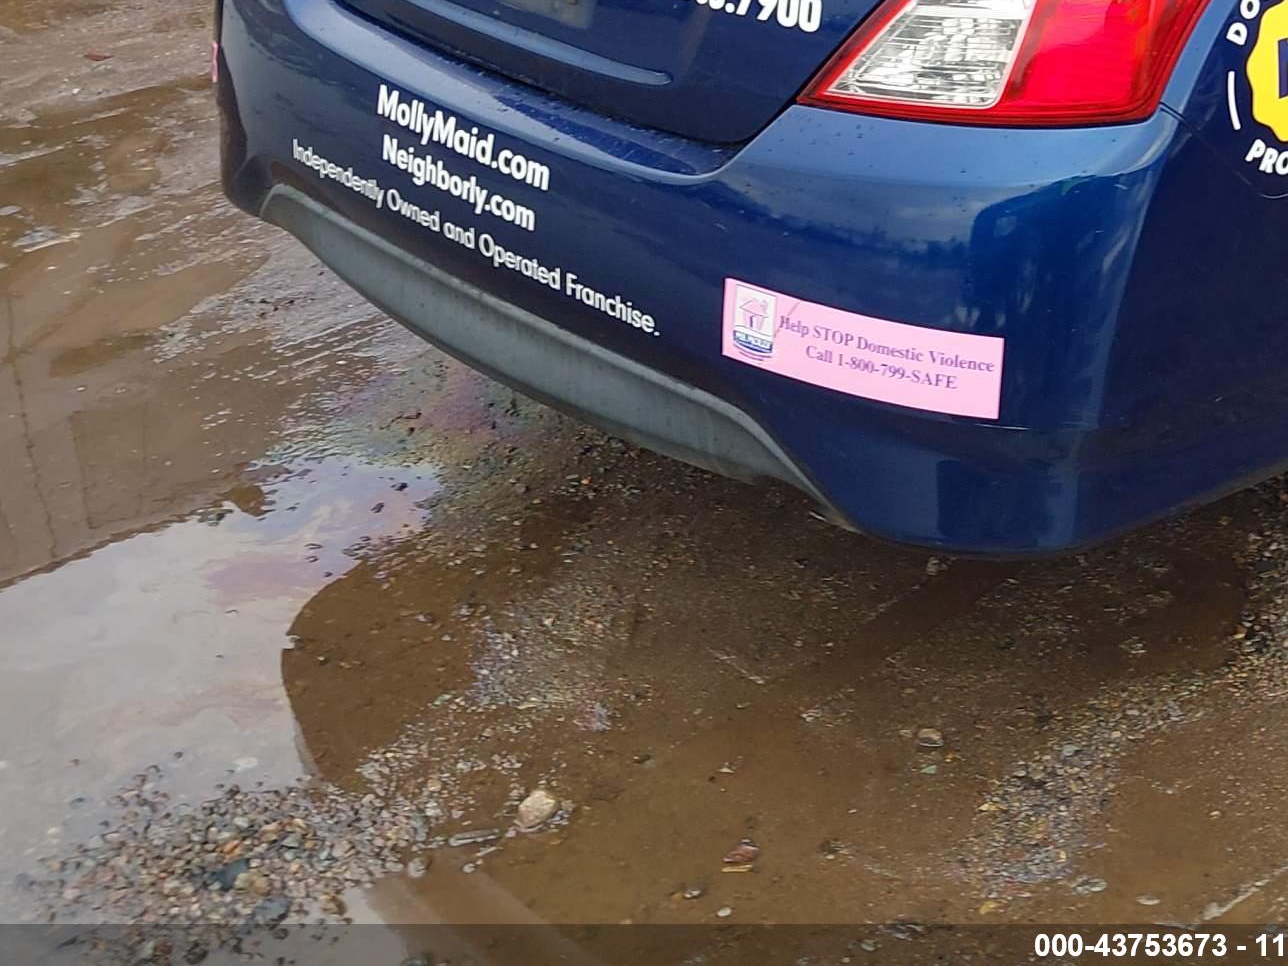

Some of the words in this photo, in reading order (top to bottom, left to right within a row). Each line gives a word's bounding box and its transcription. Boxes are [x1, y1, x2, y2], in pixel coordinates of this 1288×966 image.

[377, 84, 550, 190] MollyMaid.com
[382, 135, 535, 231] Neighborly.com
[292, 138, 384, 208] Independently
[386, 188, 440, 233] Owned
[442, 218, 475, 250] and
[478, 233, 561, 290] Operated
[566, 273, 660, 337] Franchise.
[780, 315, 809, 338] Help
[812, 326, 853, 350] STOP
[857, 336, 924, 362] Domestic
[928, 350, 995, 373] Violence
[806, 345, 833, 363] Call
[837, 353, 957, 390] 1-800-799-SAFE
